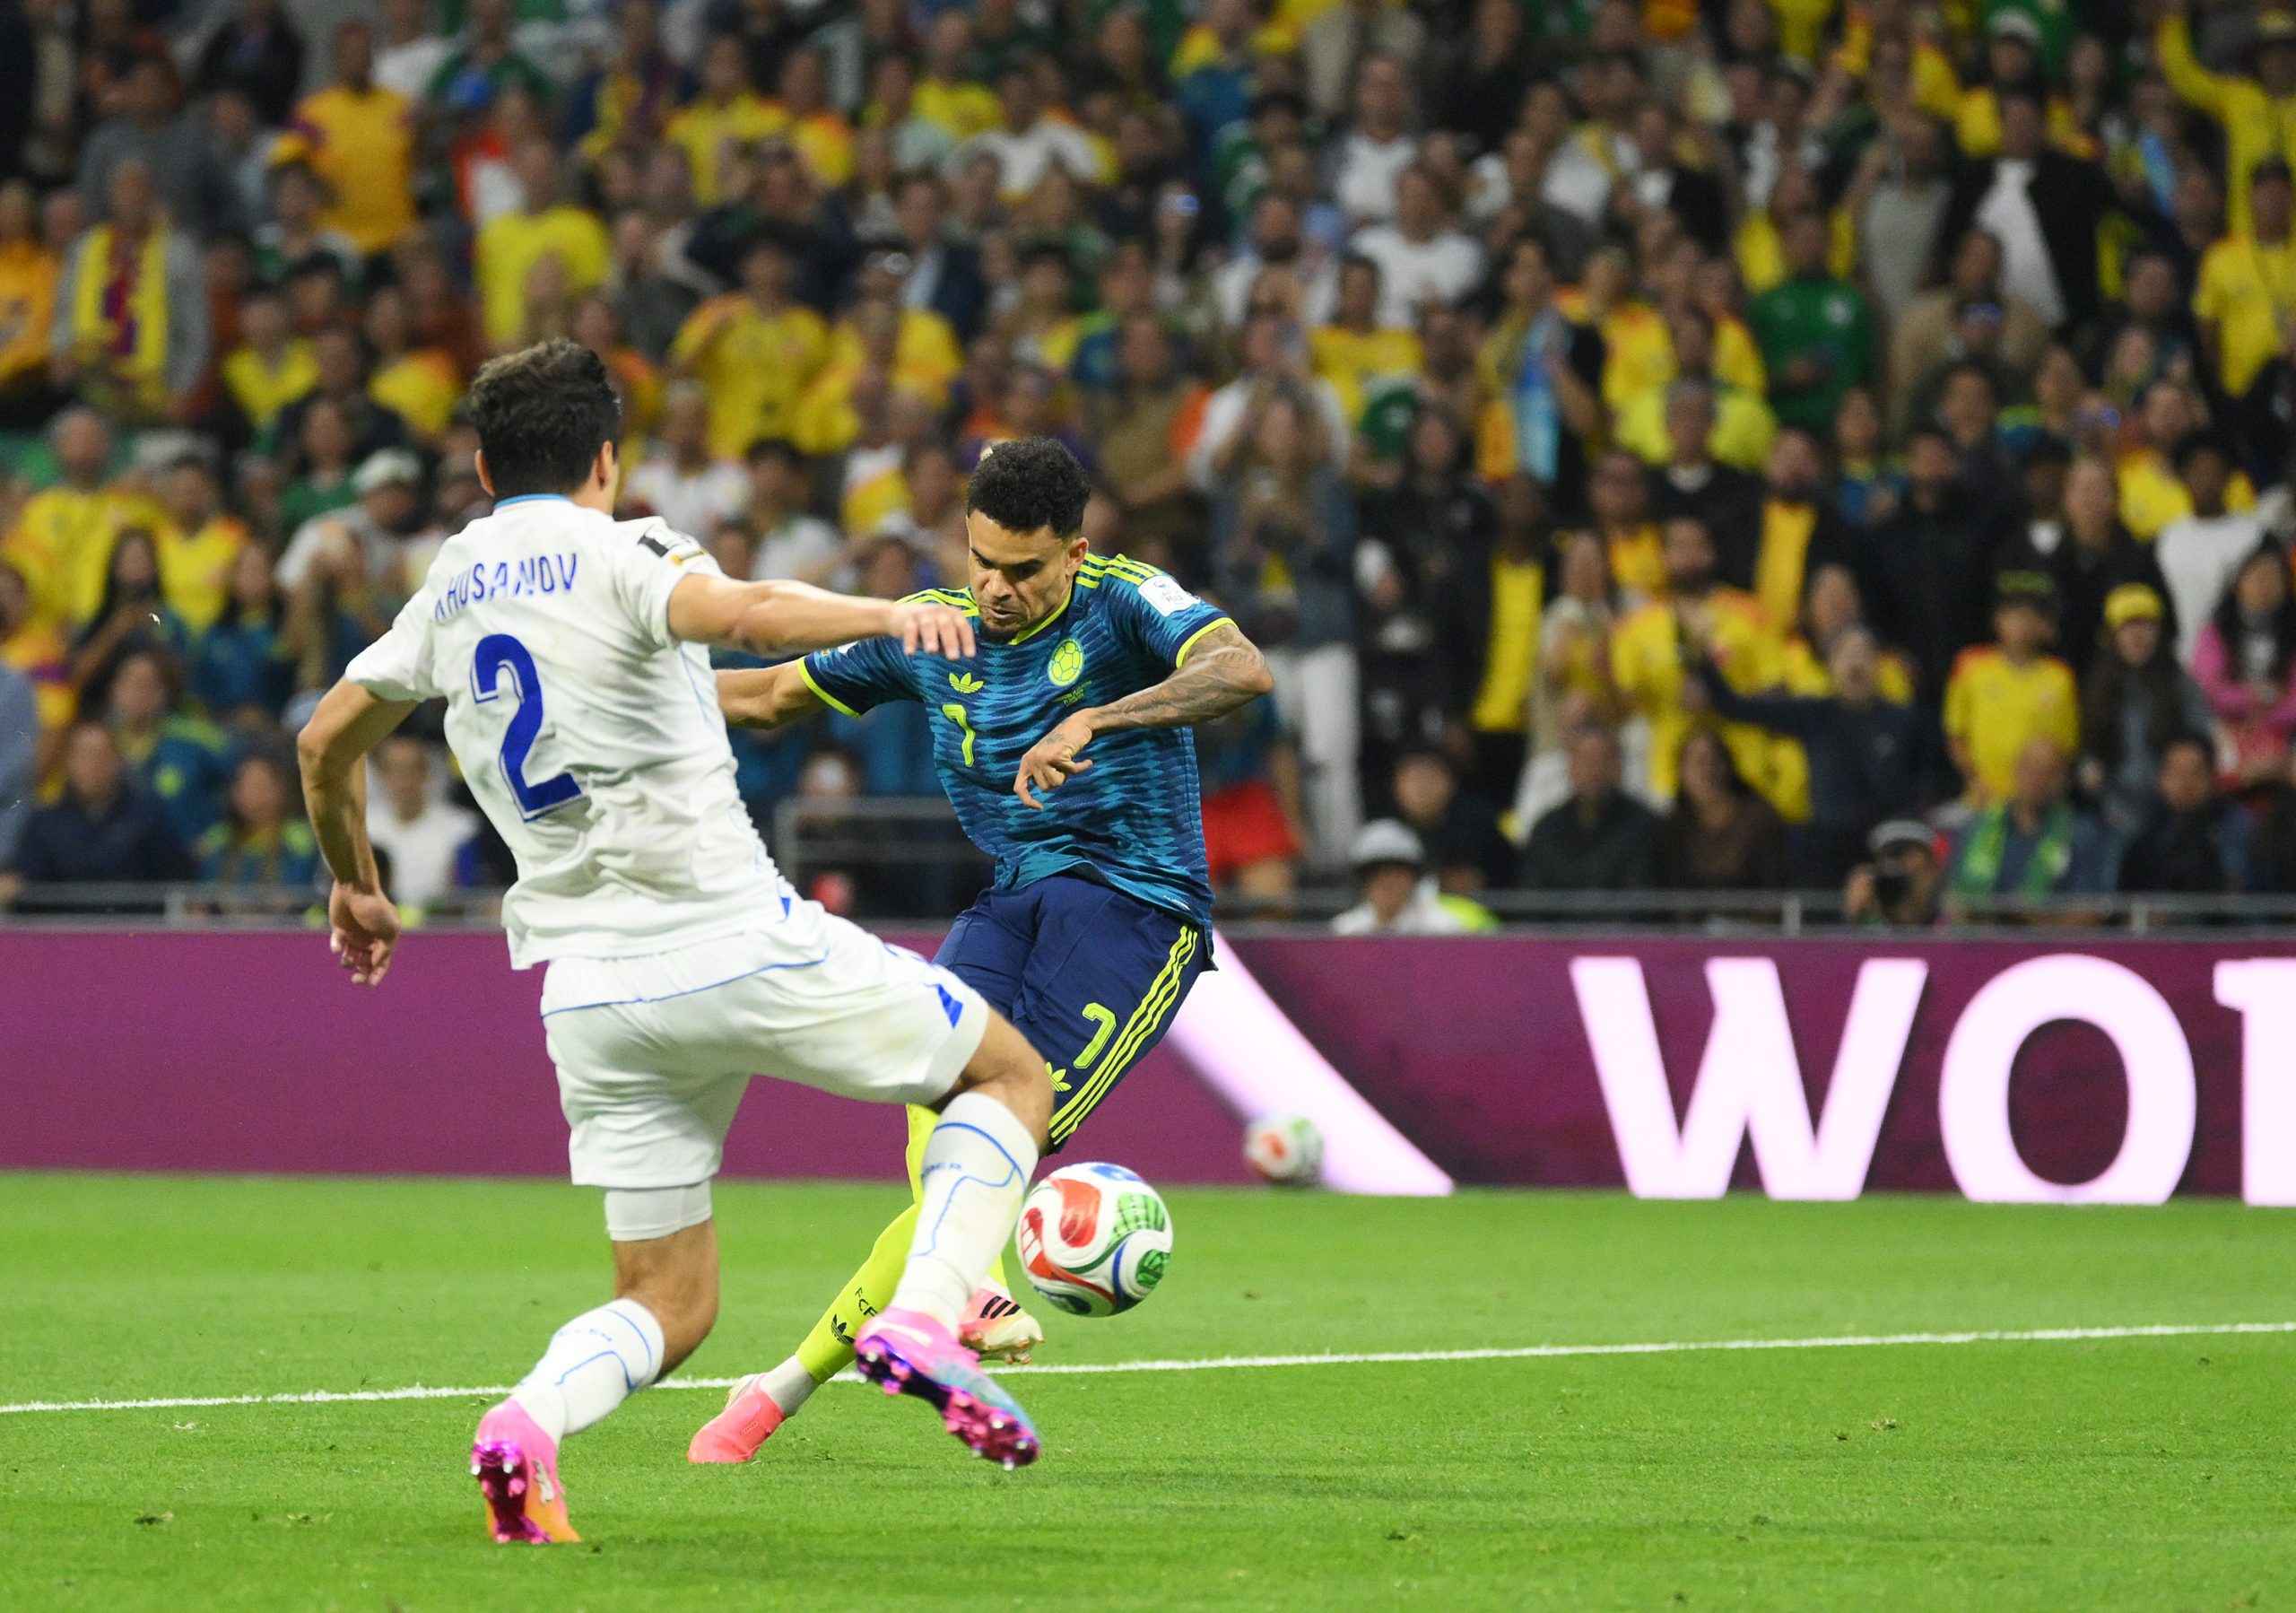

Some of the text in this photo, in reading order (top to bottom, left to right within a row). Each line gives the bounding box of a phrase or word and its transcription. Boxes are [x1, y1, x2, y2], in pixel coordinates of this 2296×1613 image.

[469, 633, 583, 823] 2
[942, 704, 976, 767] 7
[1073, 1002, 1117, 1069] 7
[855, 1286, 878, 1317] FCF
